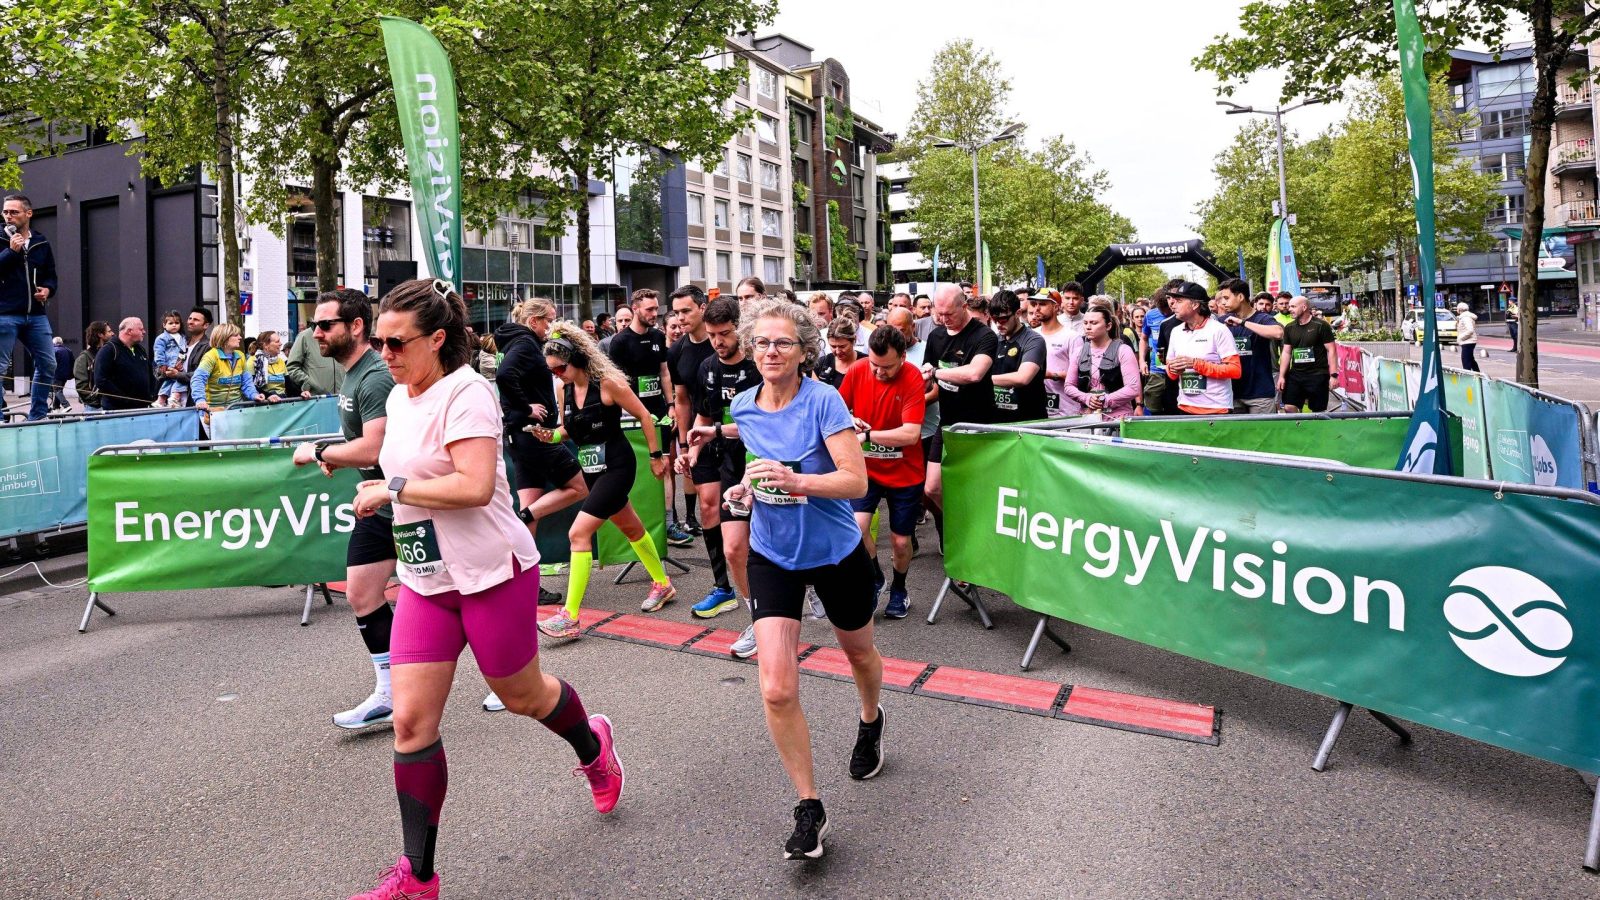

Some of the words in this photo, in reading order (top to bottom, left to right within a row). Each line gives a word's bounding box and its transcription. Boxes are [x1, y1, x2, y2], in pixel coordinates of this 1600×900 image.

[1120, 247, 1142, 256] Van
[1145, 243, 1188, 256] Mossel
[645, 382, 658, 391] 310
[581, 453, 598, 466] 370
[0, 479, 37, 492] imburg
[115, 493, 356, 550] EnergyVis
[995, 486, 1406, 632] EnergyVision
